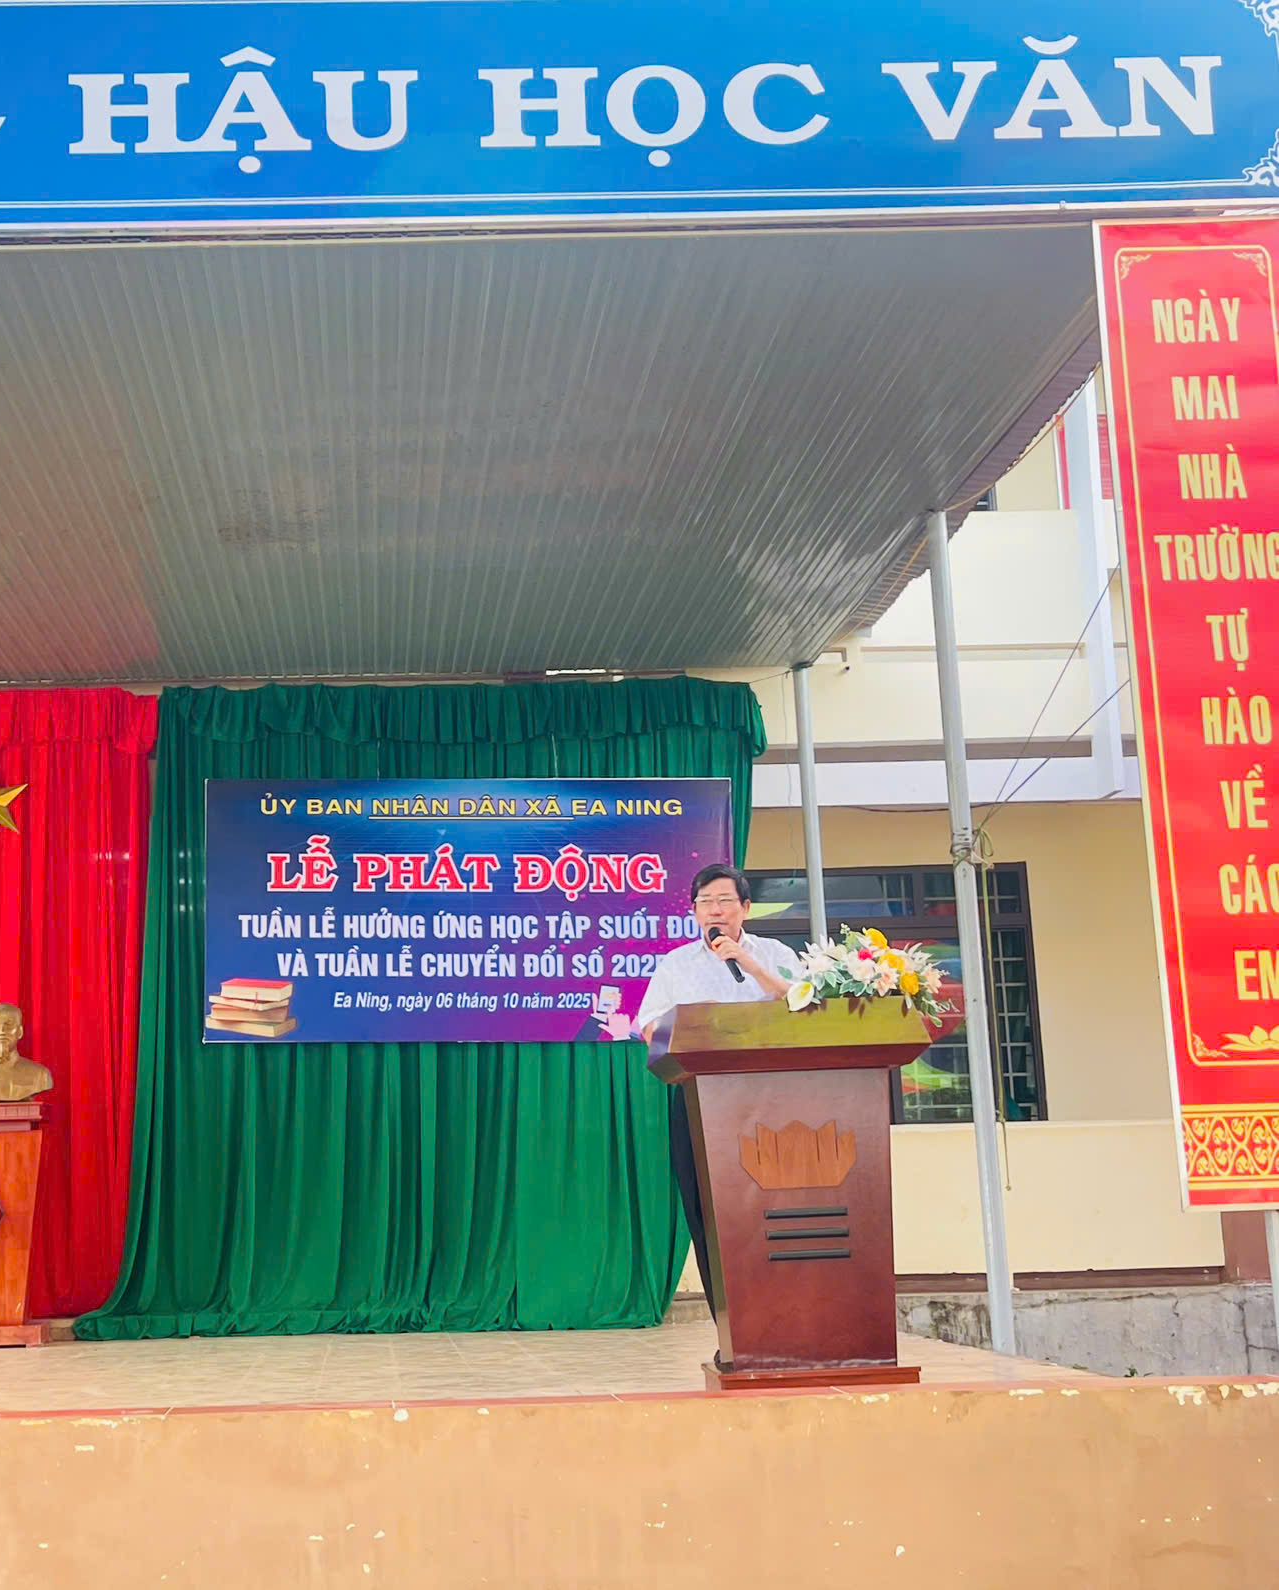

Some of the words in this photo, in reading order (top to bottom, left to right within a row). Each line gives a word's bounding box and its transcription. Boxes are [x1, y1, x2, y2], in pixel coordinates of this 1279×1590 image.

[68, 46, 418, 174] HẬU
[478, 63, 830, 168] HỌC
[881, 34, 1222, 141] VĂN
[1151, 289, 1241, 344] NGÀY
[1171, 375, 1240, 421] MAI
[1178, 443, 1247, 499] NHÀ
[1154, 523, 1279, 581] TRƯỜNG
[1205, 607, 1250, 671] TỰ
[1201, 687, 1272, 745] HÀO
[260, 793, 297, 816] ỦY
[306, 798, 362, 816] BAN
[372, 794, 449, 816] NHÂN
[459, 794, 516, 816] DÂN
[525, 794, 562, 816] XÃ
[571, 798, 607, 816] EA
[616, 798, 683, 816] NING
[1219, 763, 1269, 829] VỀ
[267, 834, 339, 892] LỄ
[353, 843, 501, 892] PHÁT
[513, 843, 667, 902] ĐỘNG
[238, 906, 301, 939] TUẦN
[309, 906, 336, 939] LỄ
[343, 907, 426, 939] HƯỞNG
[432, 909, 483, 939] ỨNG
[490, 914, 539, 945] HỌC
[545, 910, 591, 945] TẬP
[598, 906, 660, 939] SUỐT
[276, 947, 309, 977] VÀ
[315, 945, 379, 977] TUẦN
[385, 944, 414, 977] LỄ
[421, 944, 517, 978] CHUYỂN
[522, 944, 564, 978] ĐỔI
[571, 945, 605, 978] SỐ
[333, 992, 352, 1009] Ea
[355, 991, 392, 1012] Ning,
[396, 992, 433, 1012] ngày
[435, 992, 453, 1009] 06
[457, 992, 498, 1012] tháng
[503, 992, 519, 1009] 10
[522, 992, 553, 1009] năm
[556, 992, 591, 1010] 2025
